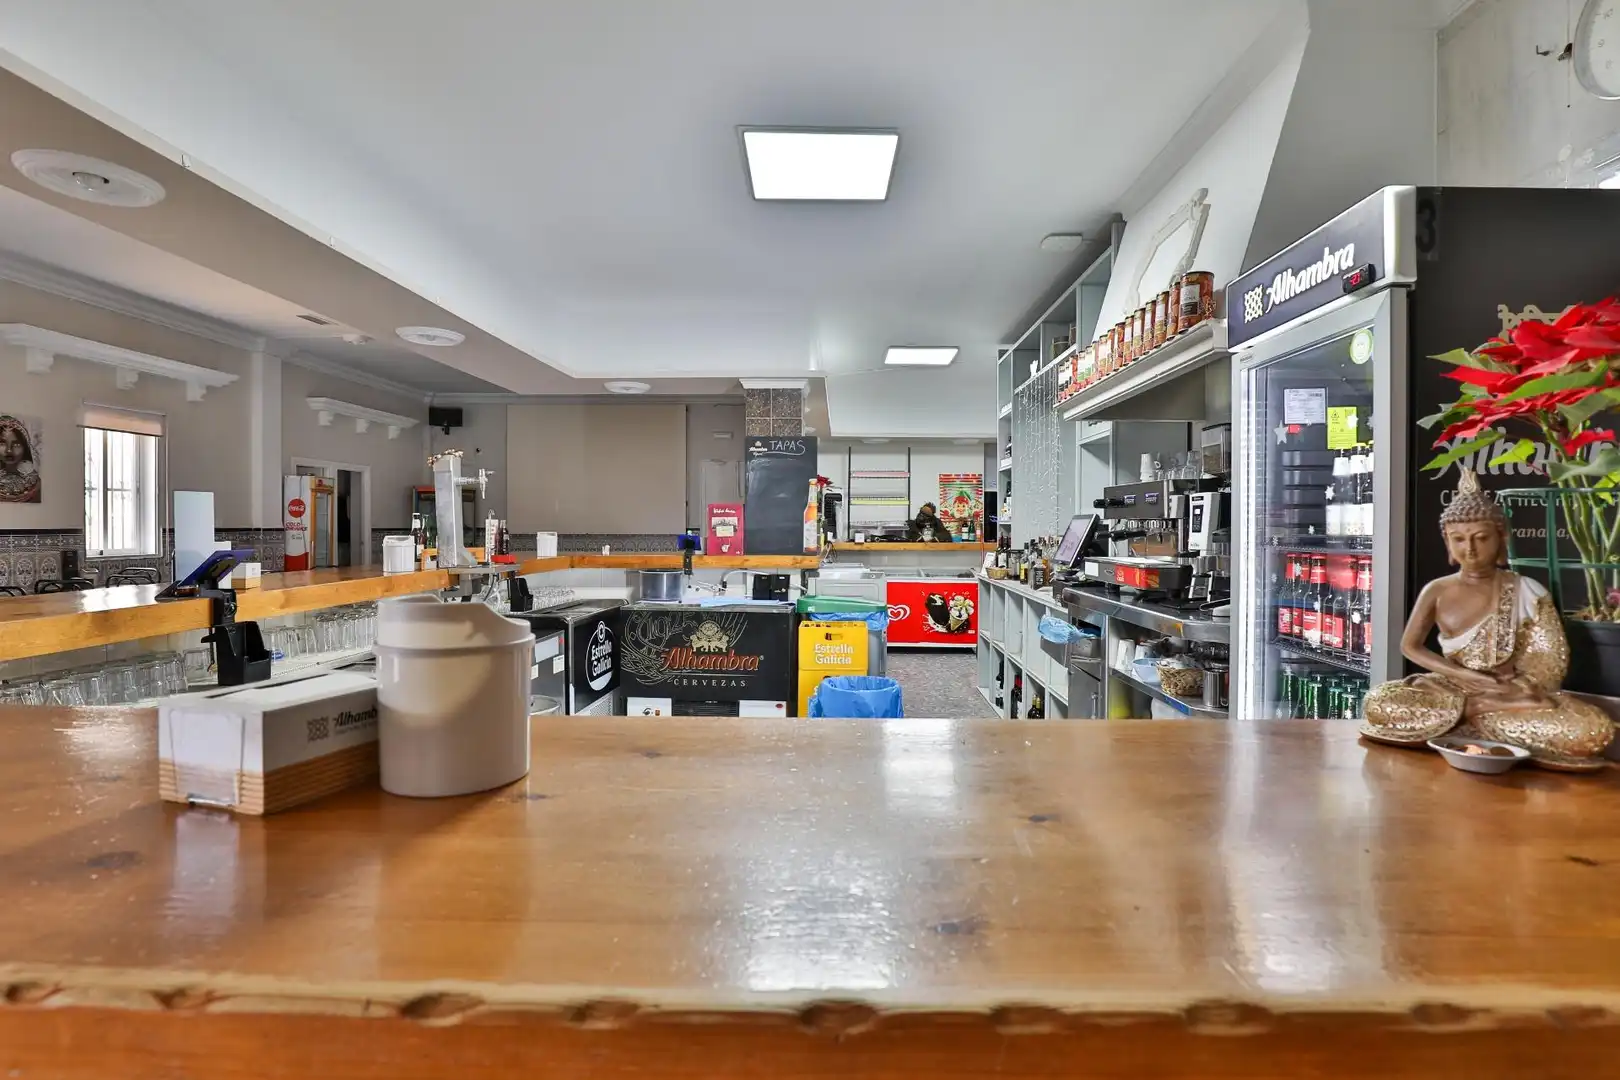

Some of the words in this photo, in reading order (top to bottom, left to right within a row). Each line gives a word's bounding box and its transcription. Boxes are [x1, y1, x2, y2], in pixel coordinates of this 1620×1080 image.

[1265, 243, 1355, 314] Alhambra
[768, 440, 805, 454] TAPAS
[815, 643, 853, 654] Estrella
[660, 648, 759, 672] Alhambra
[816, 653, 852, 665] Galicia
[673, 678, 747, 687] CERVEZAS
